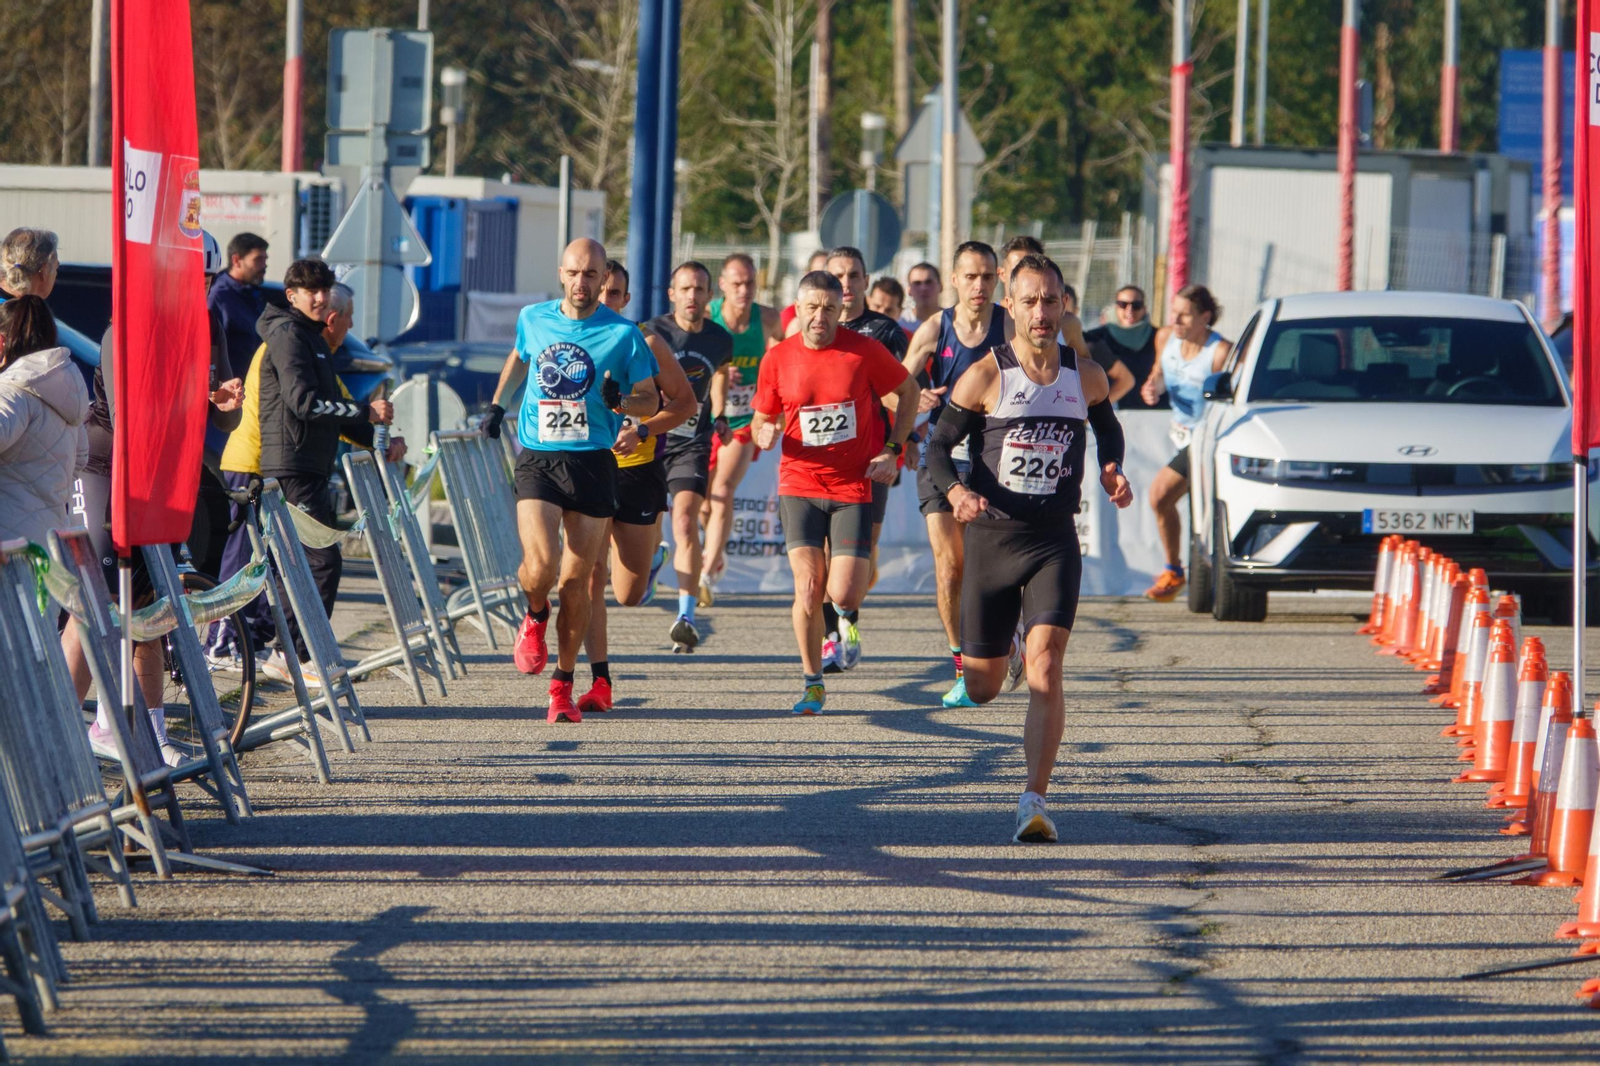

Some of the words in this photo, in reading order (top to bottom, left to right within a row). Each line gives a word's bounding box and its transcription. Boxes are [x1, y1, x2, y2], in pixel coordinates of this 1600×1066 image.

[551, 343, 585, 356] RUNNERS
[544, 387, 557, 398] AND
[546, 411, 586, 428] 224
[808, 413, 849, 434] 222
[1009, 456, 1060, 479] 226
[734, 518, 769, 539] ega
[1378, 512, 1426, 530] 5362
[1432, 513, 1470, 530] NFN
[725, 537, 788, 557] etismo
